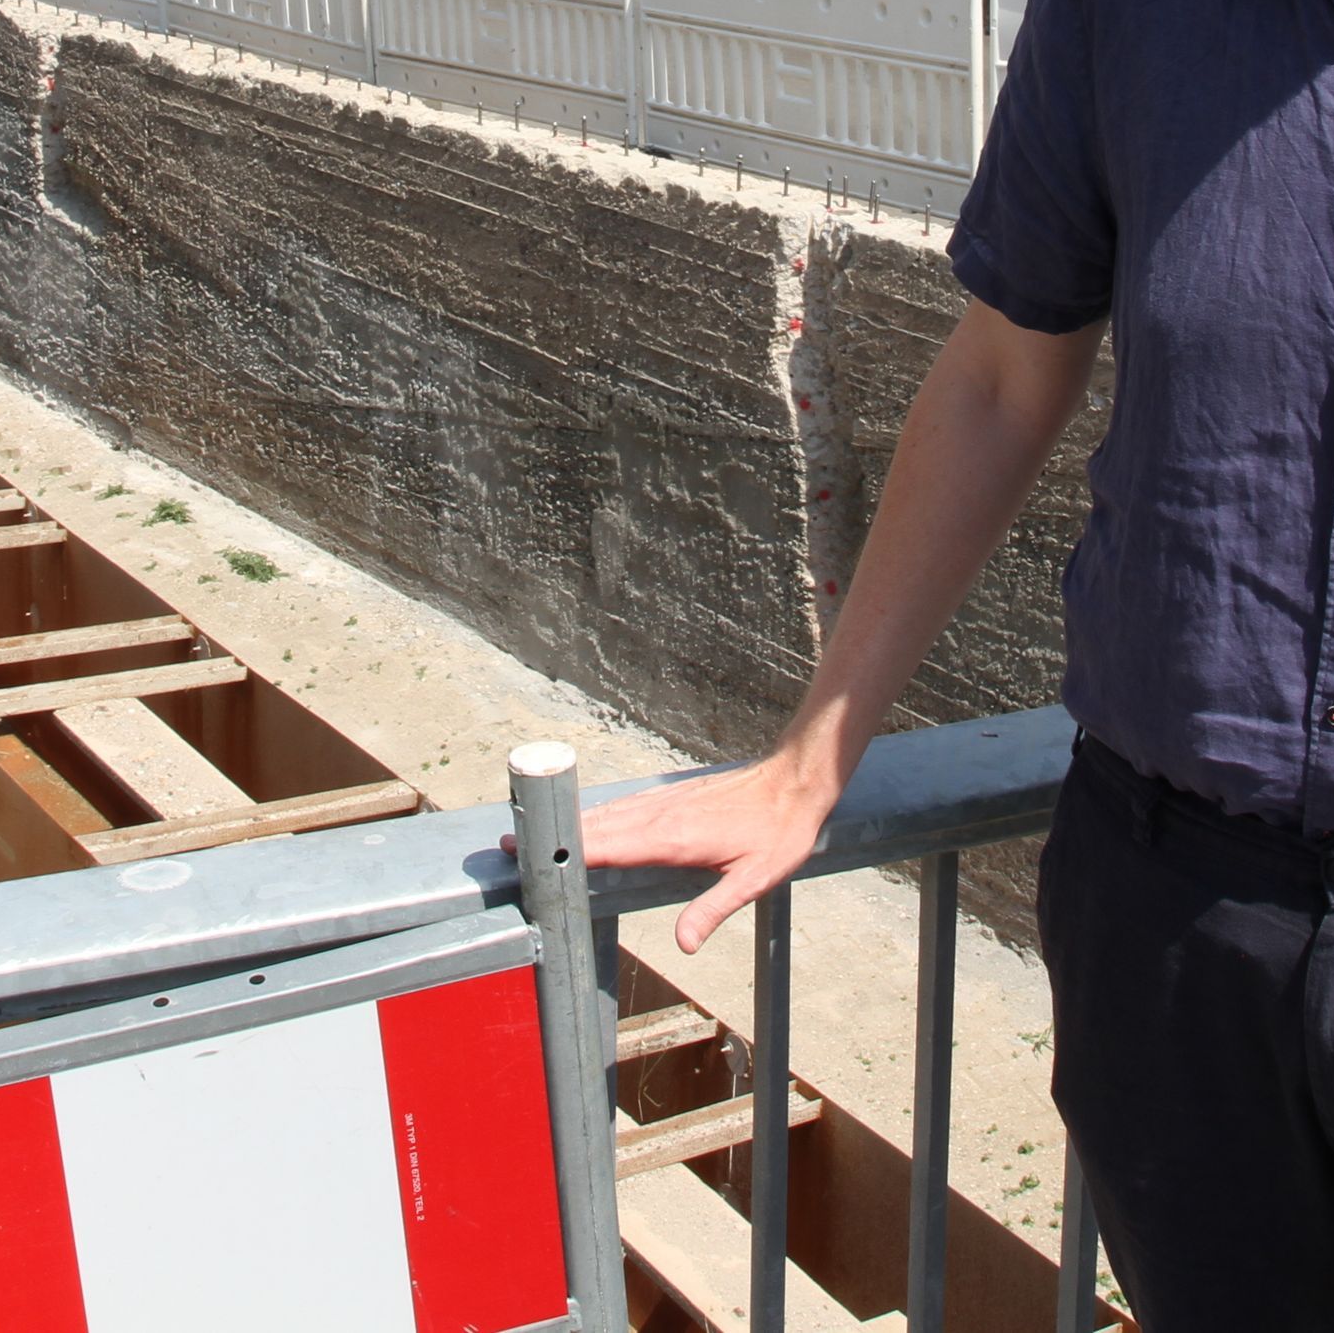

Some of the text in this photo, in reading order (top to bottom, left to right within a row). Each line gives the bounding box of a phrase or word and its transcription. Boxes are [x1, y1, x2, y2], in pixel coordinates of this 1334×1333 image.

[404, 1113, 413, 1126] 3M
[407, 1126, 416, 1144] TYP
[410, 1152, 418, 1168] DIN
[415, 1195, 424, 1214] TEIL
